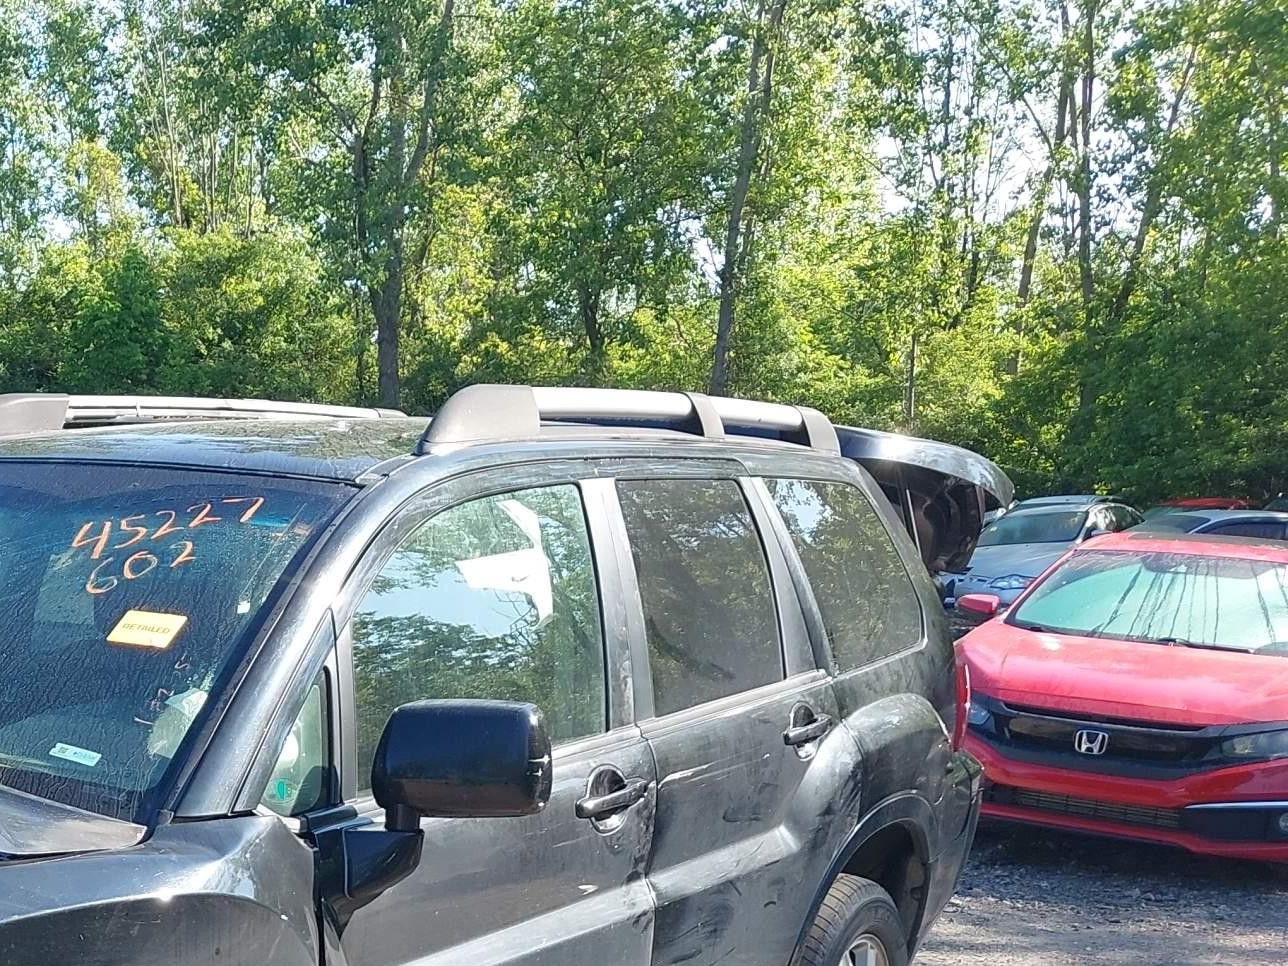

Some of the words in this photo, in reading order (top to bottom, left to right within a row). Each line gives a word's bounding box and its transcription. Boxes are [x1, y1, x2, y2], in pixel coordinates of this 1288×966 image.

[72, 497, 264, 559] 45227
[86, 541, 196, 594] 602
[122, 623, 170, 634] DETAILED
